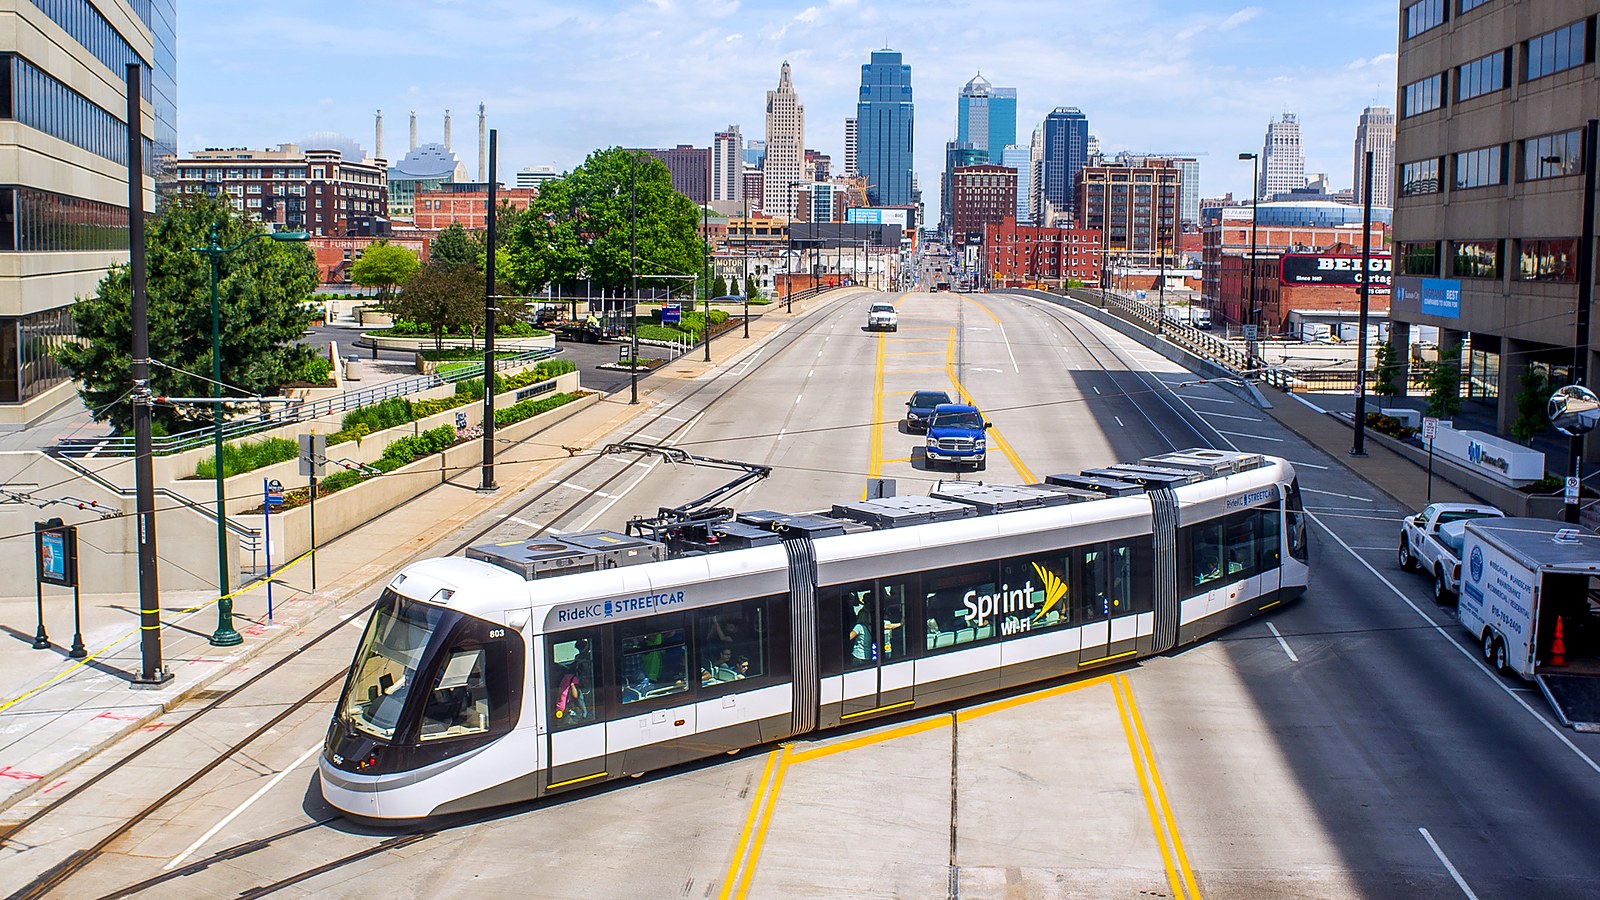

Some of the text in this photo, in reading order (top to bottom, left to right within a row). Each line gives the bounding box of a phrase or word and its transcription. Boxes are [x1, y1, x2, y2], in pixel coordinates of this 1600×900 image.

[1354, 273, 1391, 285] Crtag
[1446, 289, 1458, 300] BEST
[1226, 489, 1275, 509] RideKC STREETCAR
[558, 591, 684, 623] RideKC STREETCAR
[963, 580, 1035, 627] Sprint
[489, 629, 505, 639] 803
